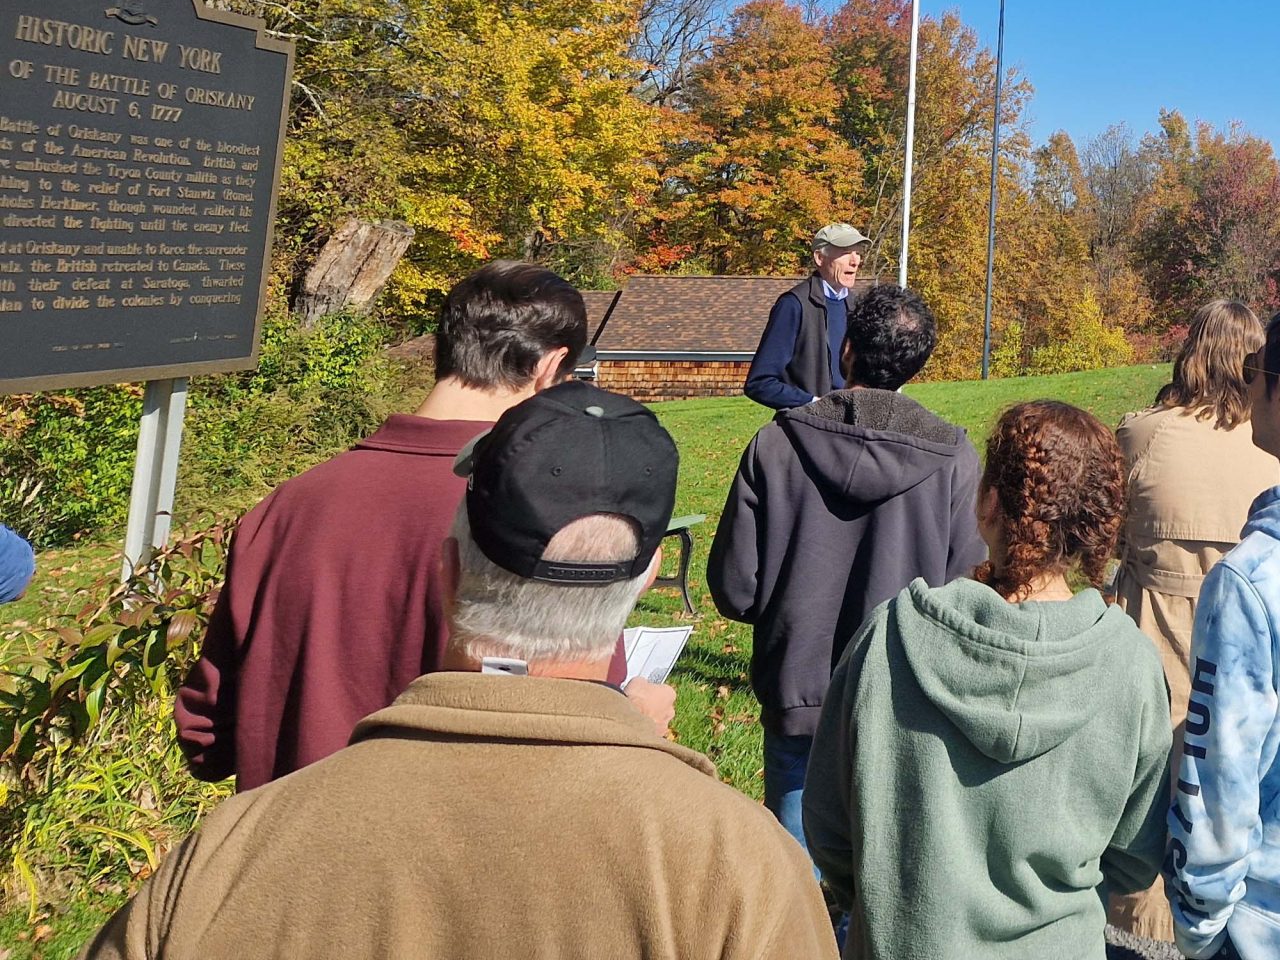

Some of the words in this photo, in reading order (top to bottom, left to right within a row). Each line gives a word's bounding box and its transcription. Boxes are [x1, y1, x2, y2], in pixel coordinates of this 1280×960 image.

[15, 14, 115, 55] HISTORIC
[123, 35, 169, 63] NEW
[178, 44, 222, 74] YORK
[9, 60, 35, 79] OF
[44, 64, 80, 86] THE
[88, 72, 151, 97] BATTLE
[158, 83, 178, 99] OF
[185, 86, 255, 111] ORISKANY
[52, 90, 120, 115] AUGUST
[151, 104, 183, 123] 1777
[46, 124, 62, 137] of
[68, 124, 122, 144] Oriskany
[130, 135, 148, 145] was
[154, 137, 173, 148] one
[179, 137, 191, 149] of
[196, 140, 212, 151] the
[217, 141, 260, 156] bloodiest
[21, 139, 37, 152] of
[44, 141, 65, 155] the
[71, 144, 127, 160] American
[203, 155, 236, 170] British
[241, 159, 259, 171] and
[15, 158, 78, 174] ambushed
[82, 161, 102, 176] the
[106, 163, 141, 180] Tryon
[145, 167, 182, 183] County
[186, 171, 218, 184] militia
[222, 176, 231, 185] as
[236, 174, 255, 188] they
[39, 178, 52, 191] to
[61, 180, 80, 194] the
[88, 182, 121, 196] relief
[128, 183, 141, 196] of
[147, 184, 171, 198] Fort
[177, 187, 215, 201] Stanwix
[107, 200, 146, 216] though
[203, 205, 235, 217] rallied
[240, 205, 253, 218] his
[3, 212, 56, 228] directed
[63, 215, 83, 229] the
[90, 216, 134, 233] fighting
[140, 219, 165, 232] until
[172, 220, 188, 232] the
[193, 222, 224, 234] enemy
[229, 221, 250, 233] fled.
[8, 242, 22, 254] at
[26, 240, 80, 256] Oriskany
[83, 242, 104, 255] and
[107, 243, 142, 255] unable
[145, 243, 157, 255] to
[160, 243, 185, 255] force
[187, 243, 203, 255] the
[205, 245, 249, 255] surrender
[31, 259, 53, 273] the
[56, 258, 98, 273] British
[101, 260, 154, 272] retreated
[157, 261, 169, 272] to
[219, 259, 246, 271] These
[27, 278, 62, 292] their
[72, 278, 110, 291] defeat
[120, 278, 133, 290] at
[202, 275, 244, 288] thwarted
[31, 297, 45, 311] to
[52, 295, 91, 310] divide
[96, 295, 116, 308] the
[121, 294, 165, 307] colonies
[170, 292, 183, 306] by
[189, 292, 242, 307] conquering
